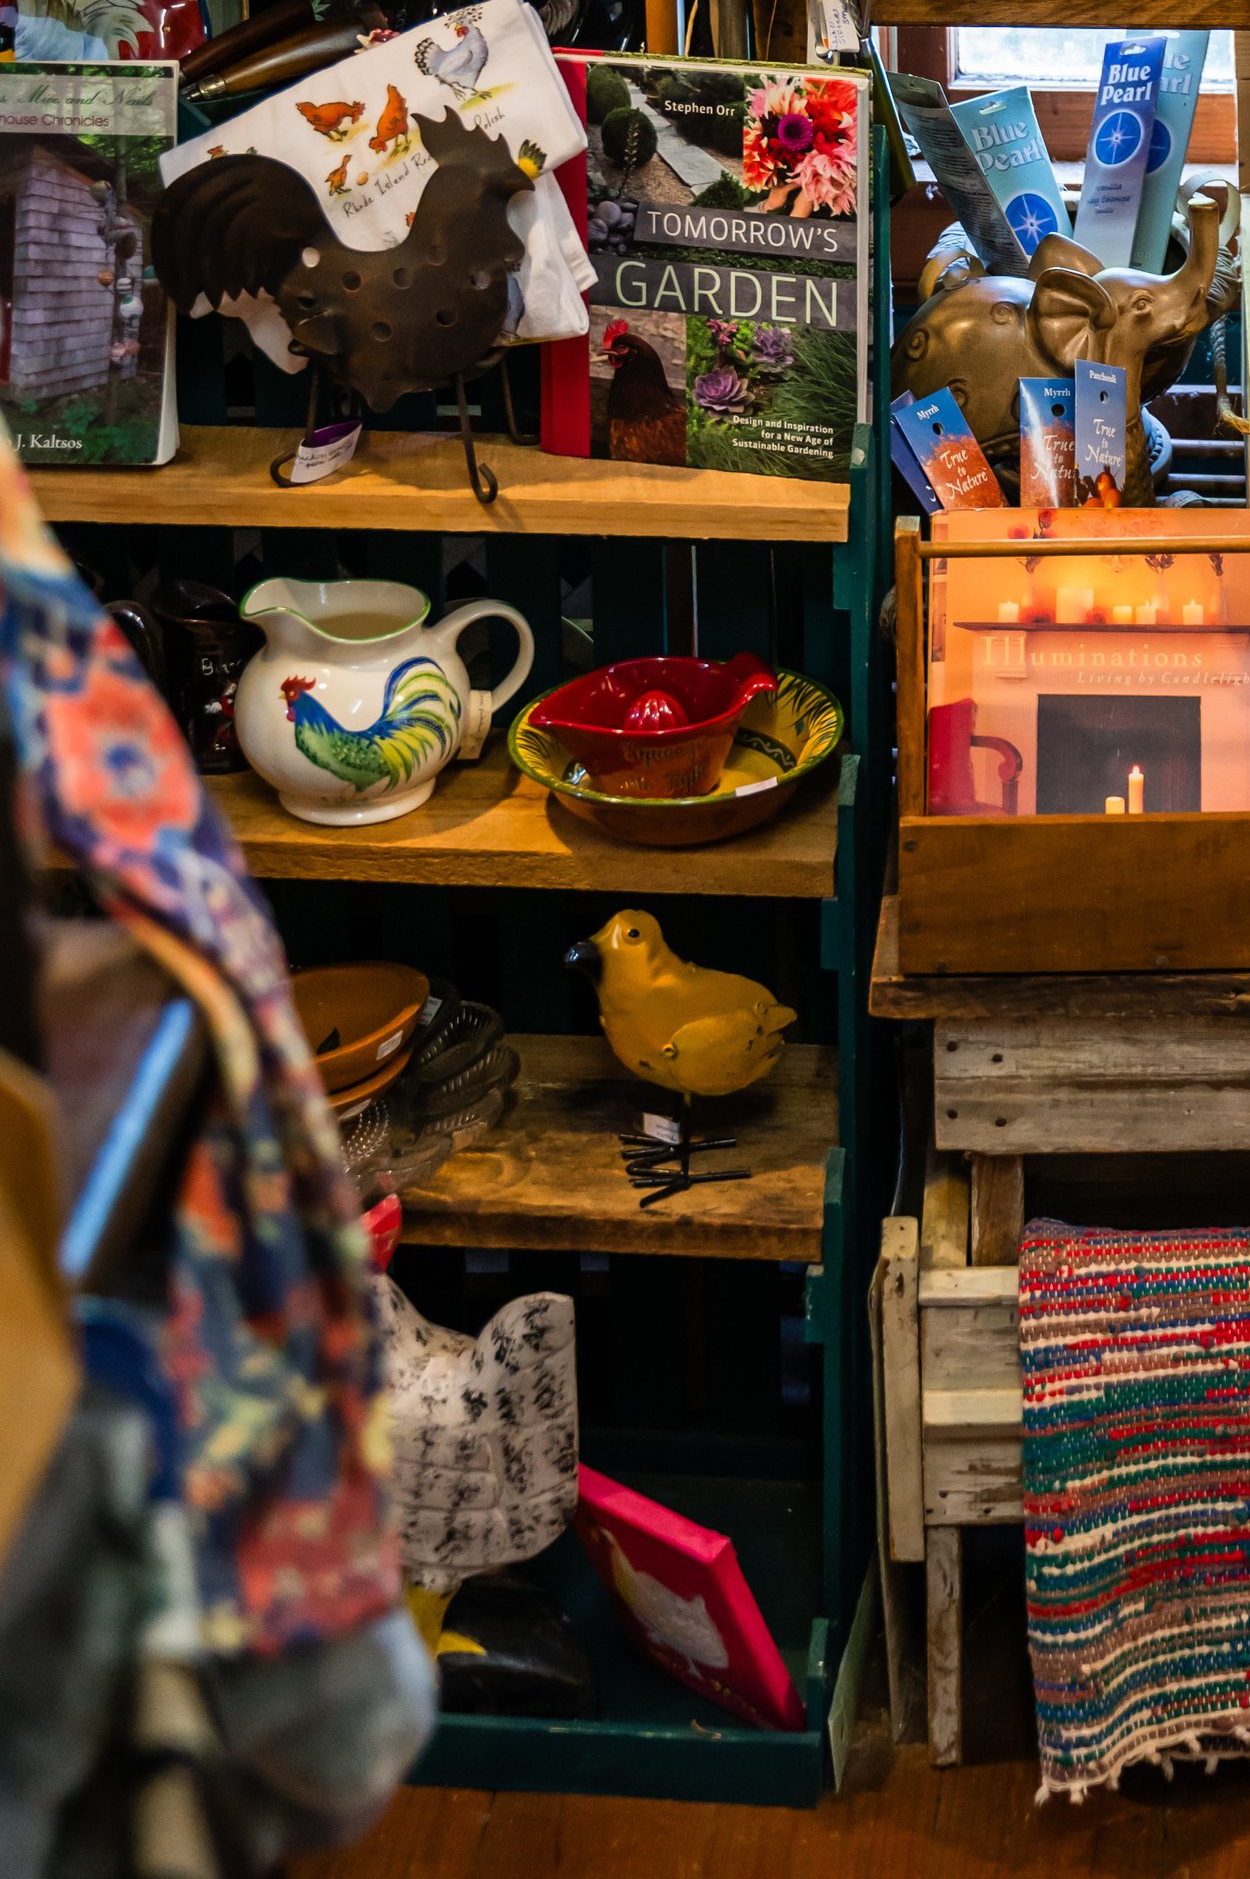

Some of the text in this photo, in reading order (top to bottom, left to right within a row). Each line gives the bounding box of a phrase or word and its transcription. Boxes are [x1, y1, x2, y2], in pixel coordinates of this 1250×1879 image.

[1107, 62, 1152, 86] Blue
[65, 90, 100, 105] and
[102, 87, 158, 107] Nails
[1101, 80, 1153, 107] Pearl
[664, 100, 736, 117] Stephen Orr
[41, 113, 109, 128] Chronicles
[969, 121, 1029, 153] Blue
[974, 139, 1043, 177] Pearl
[341, 164, 410, 219] Rhode Island
[646, 210, 839, 253] TOMORROW'S
[615, 260, 837, 327] GARDEN
[1089, 369, 1117, 384] Patchouli
[1043, 387, 1071, 399] Myrrh
[916, 403, 940, 421] Myrrh
[732, 415, 834, 435] Design and Inspiration
[1093, 419, 1117, 439] True
[30, 434, 83, 450] Kaltsos
[761, 429, 833, 446] for a New Age of
[1042, 434, 1075, 452] True
[1101, 438, 1109, 449] to
[732, 438, 834, 460] Sustainable Gardening
[939, 448, 969, 470] True
[1053, 453, 1065, 464] to
[1084, 443, 1124, 467] Nature
[957, 465, 967, 478] to
[945, 470, 989, 501] Nature
[980, 635, 1204, 668] Illuminations
[1077, 671, 1133, 686] Living
[1138, 671, 1155, 686] by
